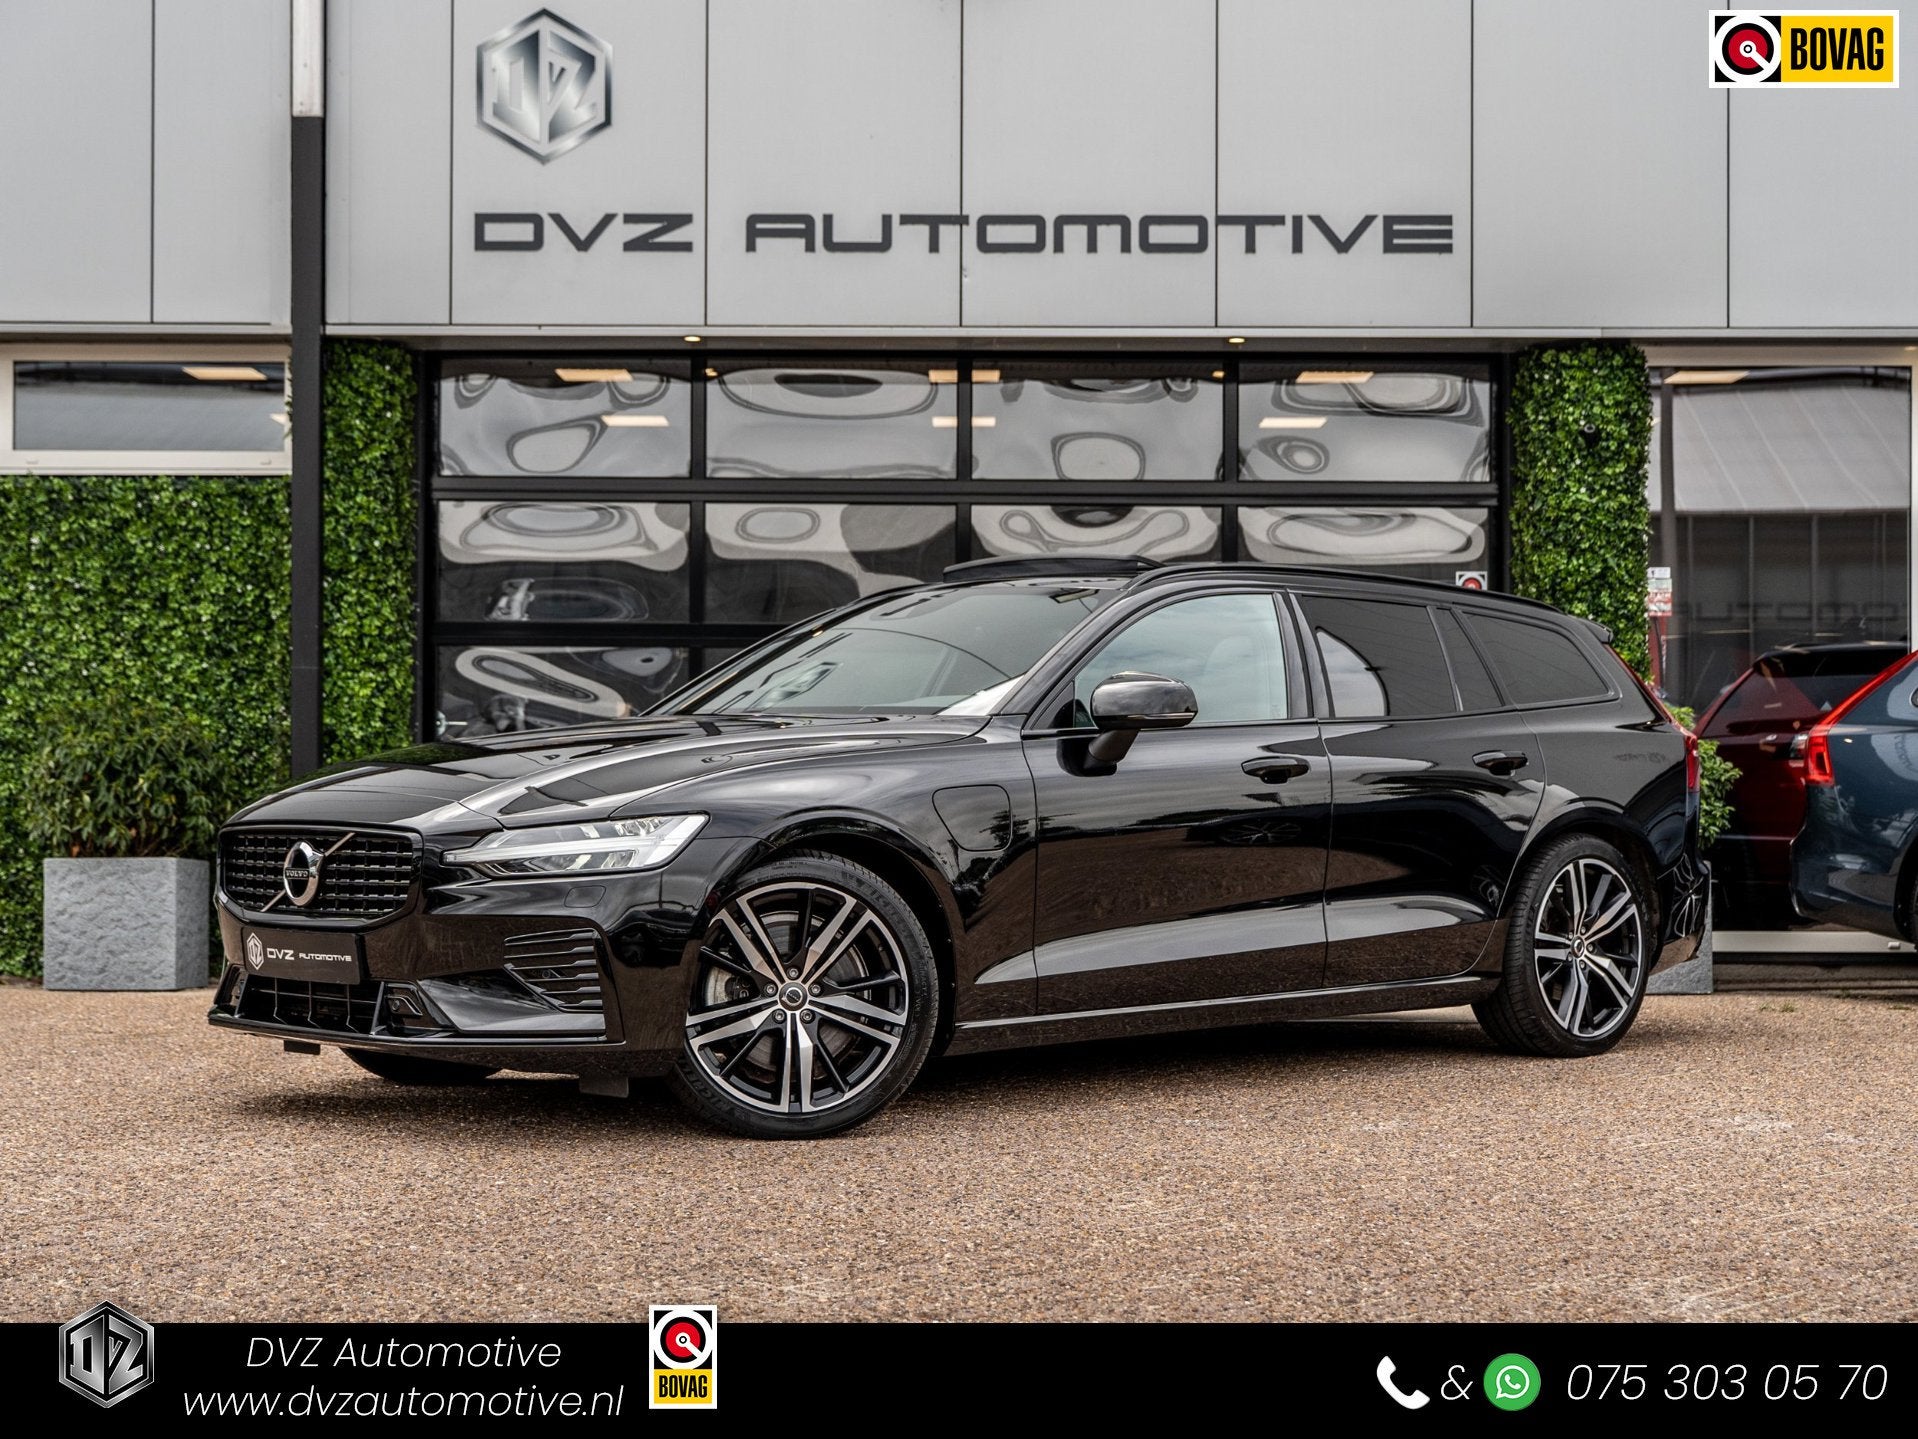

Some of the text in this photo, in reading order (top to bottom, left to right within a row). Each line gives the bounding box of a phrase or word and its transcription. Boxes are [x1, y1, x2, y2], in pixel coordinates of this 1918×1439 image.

[474, 213, 1454, 254] DVZ AUTOMOTIVE
[267, 948, 352, 962] DVZ AUTOMOTIVE
